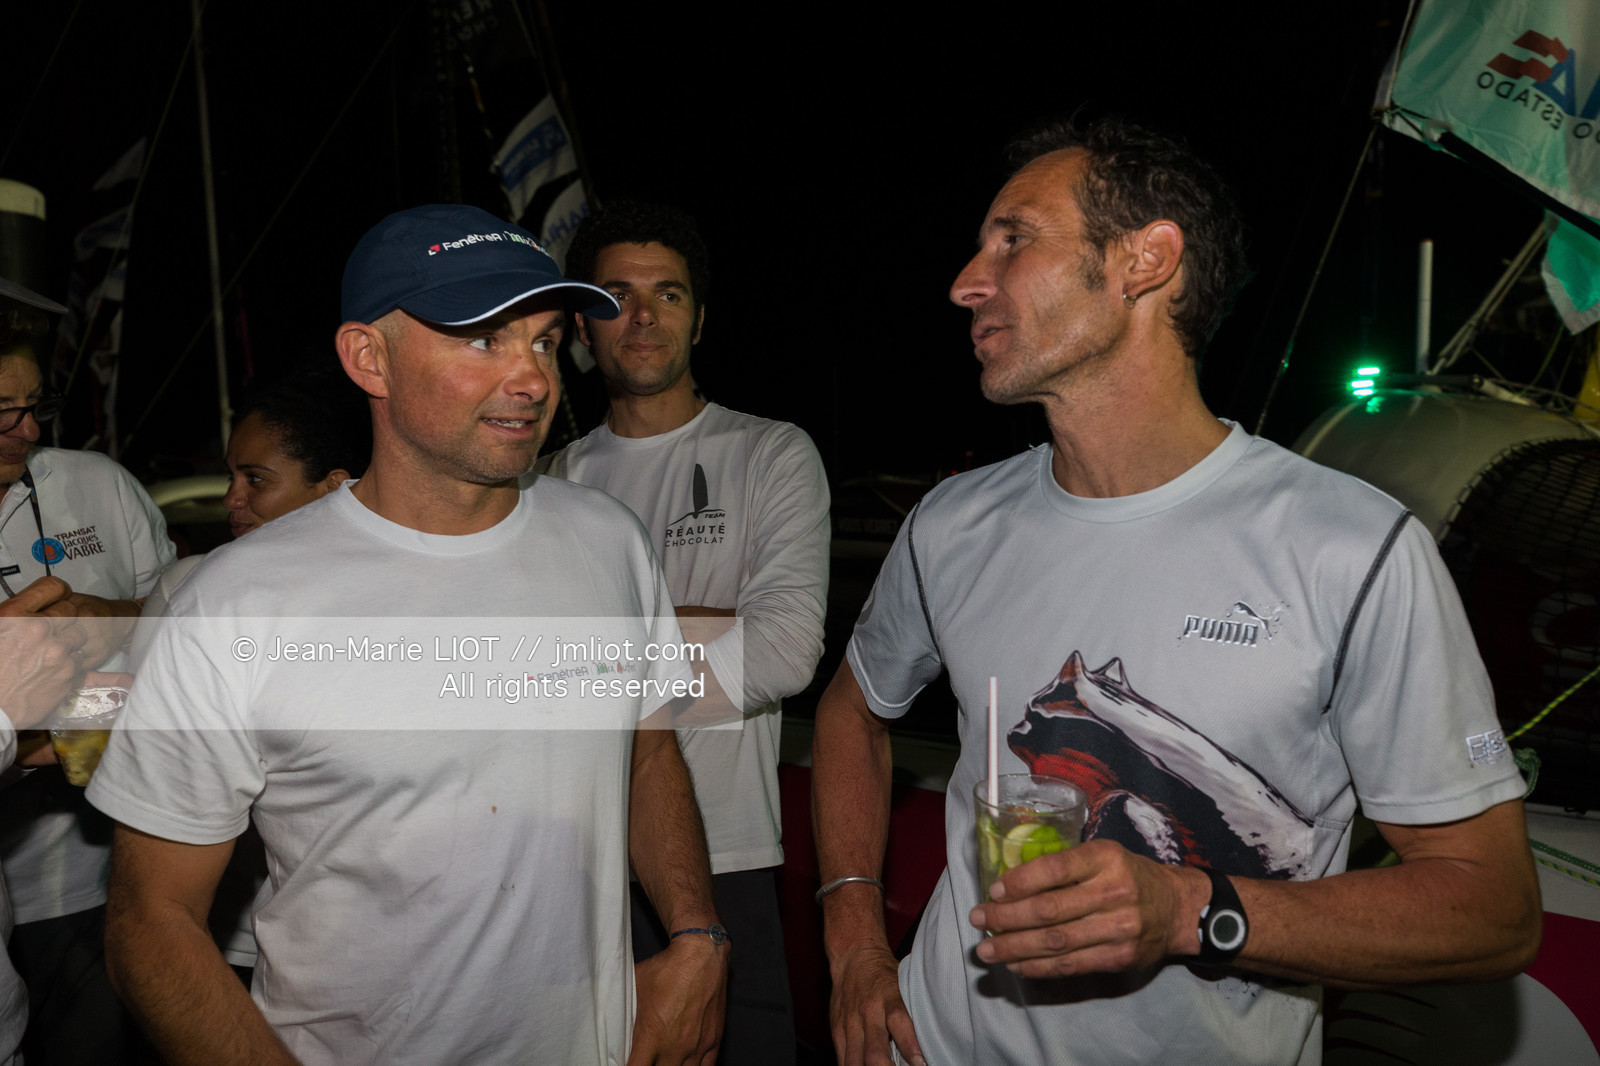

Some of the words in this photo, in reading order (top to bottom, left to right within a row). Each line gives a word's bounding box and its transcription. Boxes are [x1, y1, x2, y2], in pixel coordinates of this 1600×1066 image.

[54, 525, 97, 541] TRANSAT
[665, 522, 726, 538] RÉAUTÉ
[62, 533, 99, 550] Jacques
[664, 537, 724, 548] CHOCOLAT
[62, 541, 106, 560] VABRE
[1183, 614, 1258, 648] PUMA
